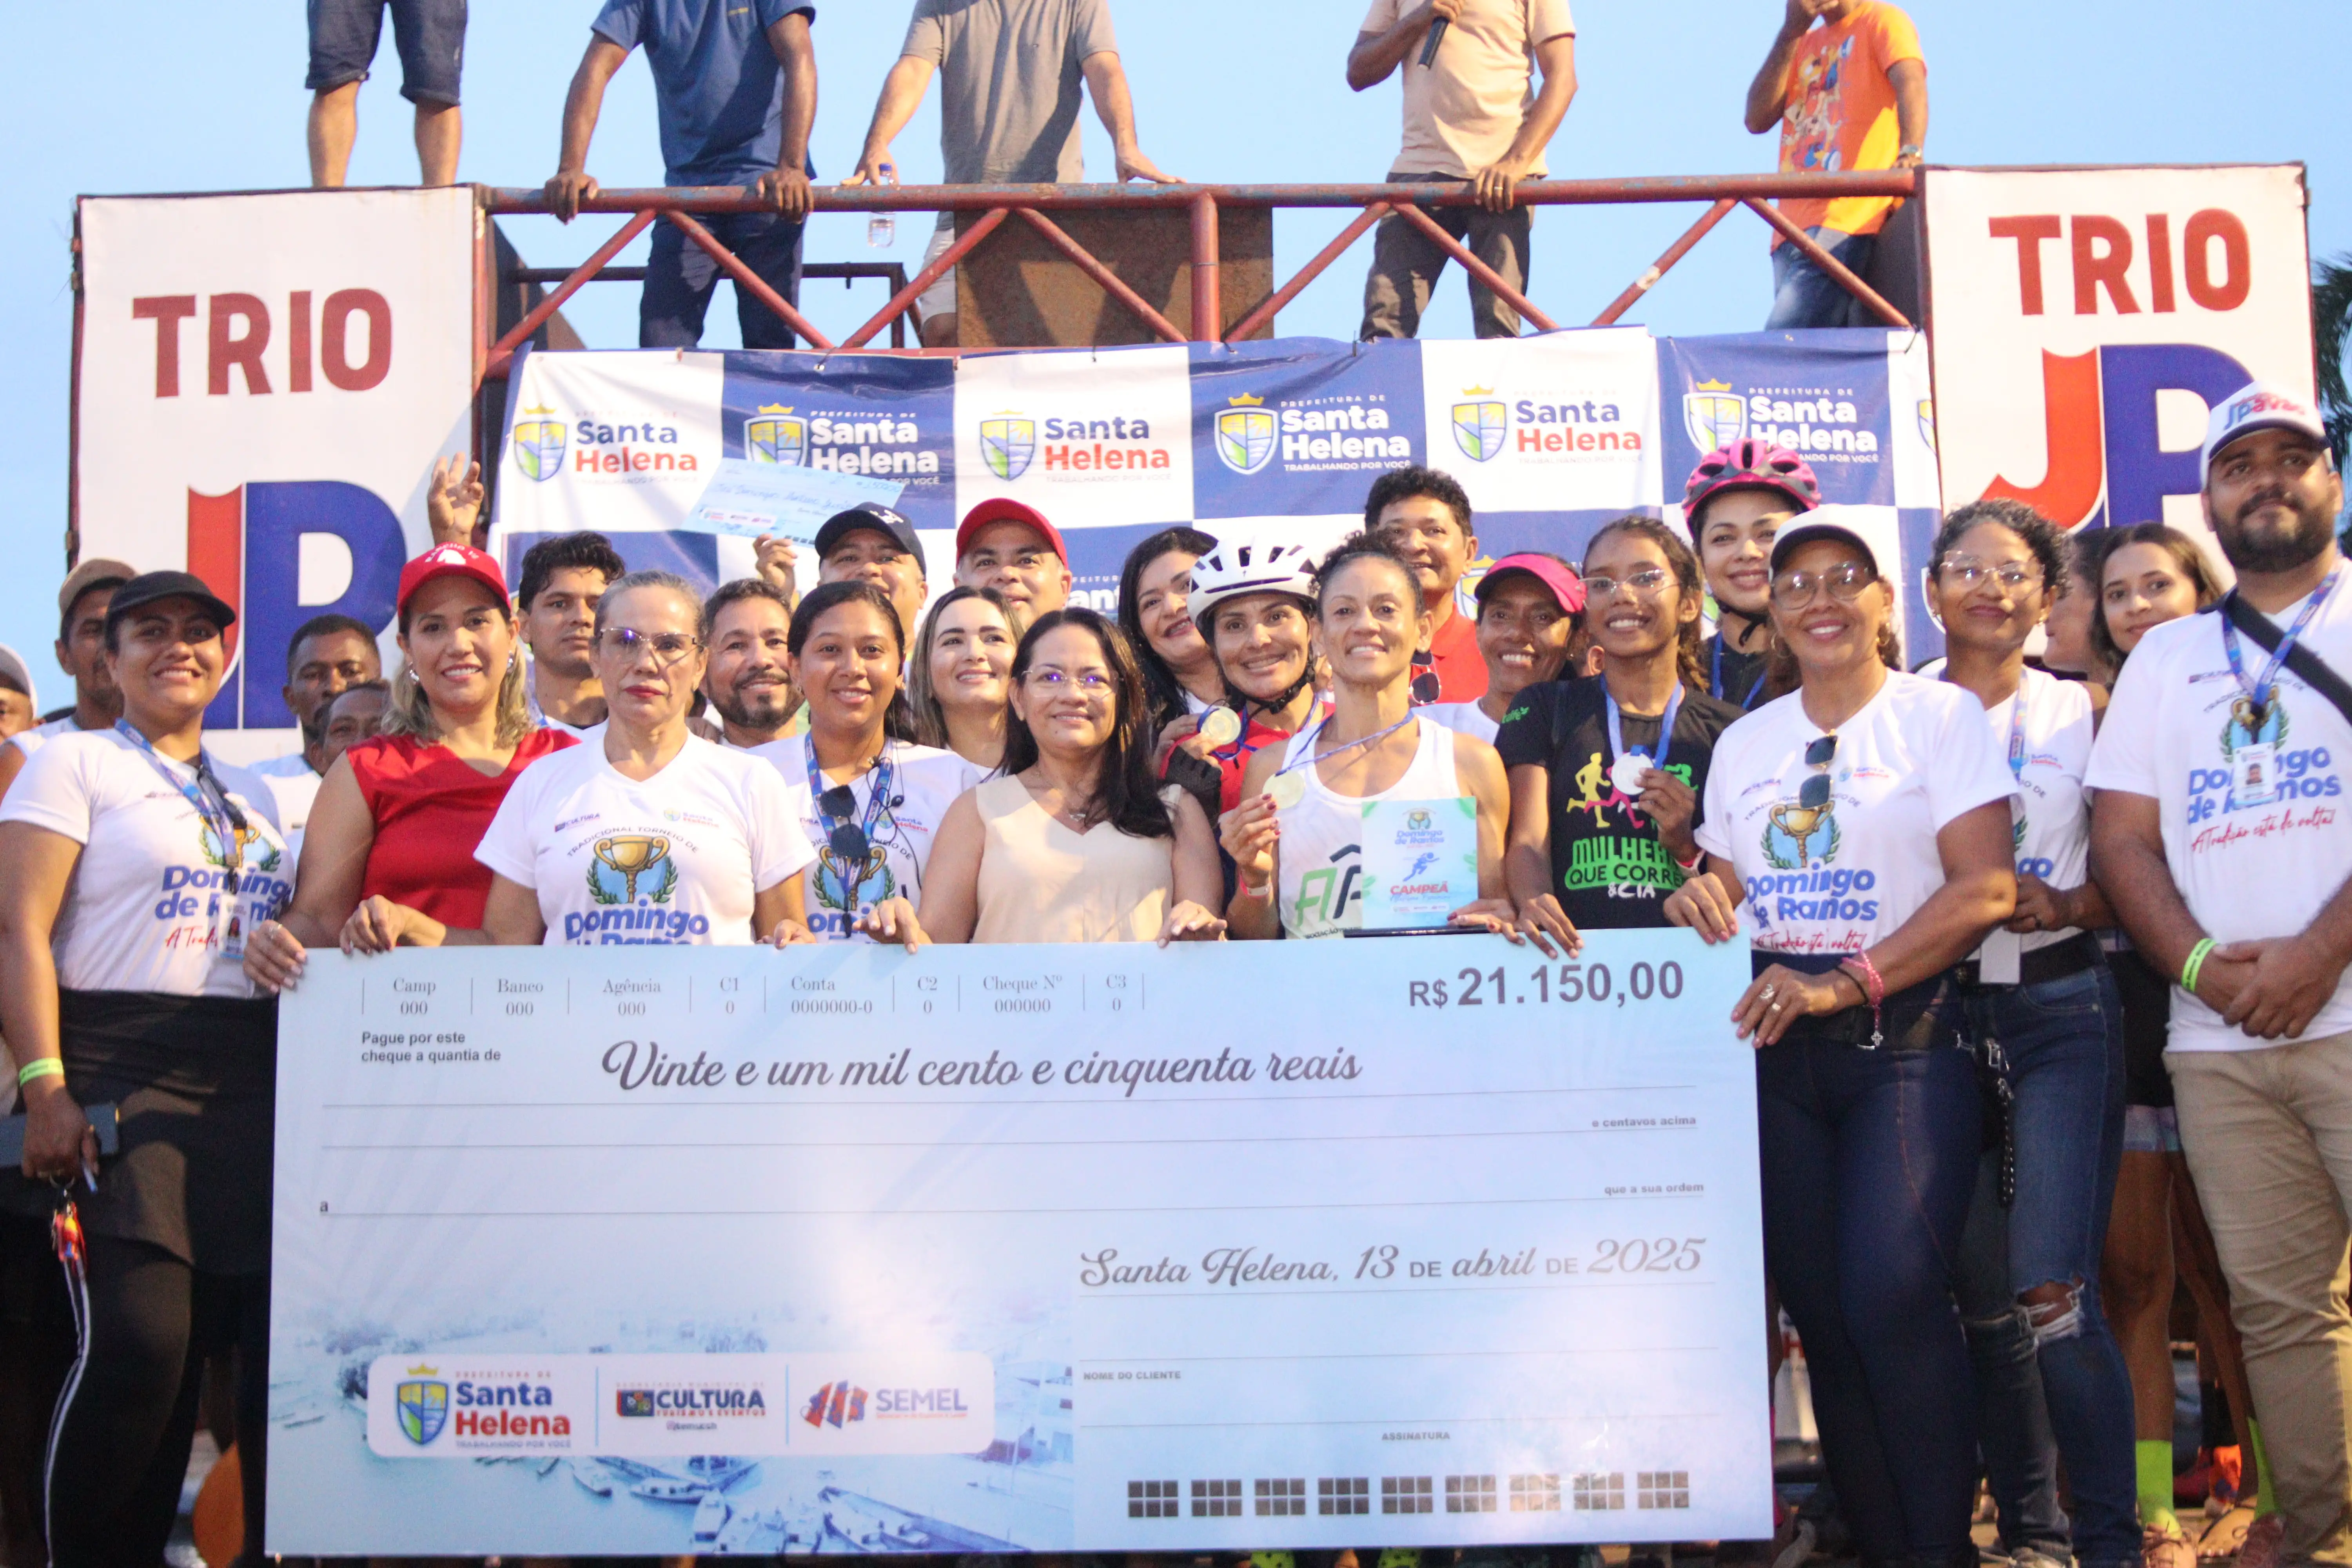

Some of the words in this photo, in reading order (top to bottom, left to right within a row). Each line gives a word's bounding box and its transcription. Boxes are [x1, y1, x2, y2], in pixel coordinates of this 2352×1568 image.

[1988, 207, 2250, 316] TRIO
[132, 288, 392, 398] TRIO
[1281, 396, 1362, 408] PREFEITURA
[1516, 400, 1619, 423] Santa
[1749, 396, 1857, 423] Santa
[1044, 417, 1149, 440] Santa
[1281, 405, 1389, 432] Santa
[577, 420, 677, 445] Santa
[810, 418, 918, 445] Santa
[1517, 427, 1641, 452] Helena
[1751, 423, 1878, 453] Helena
[1978, 343, 2255, 527] JP
[1045, 443, 1170, 471] Helena
[1282, 432, 1410, 460] Helena
[576, 446, 698, 473] Helena
[811, 446, 939, 474] Helena
[1283, 462, 1359, 471] TRABALHANDO
[1361, 461, 1382, 469] POR
[1384, 459, 1411, 468] VOCÊ
[1829, 455, 1850, 463] POR
[1851, 454, 1879, 463] VOCÊ
[912, 476, 940, 485] VOCÊ
[187, 480, 408, 730] JP
[1847, 797, 1861, 808] DE
[2188, 796, 2216, 825] de
[564, 813, 601, 826] CULTURA
[567, 826, 634, 857] TRADICIONAL
[638, 826, 684, 843] TORNEIO
[685, 840, 699, 854] DE
[899, 848, 913, 860] DE
[1570, 865, 1608, 885] QUE
[1390, 880, 1448, 895] CAMPEÃ
[1608, 880, 1656, 899] &CIA
[152, 891, 198, 920] de
[564, 898, 710, 940] Domingo
[393, 977, 436, 995] Camp
[497, 978, 544, 994] Banco
[602, 978, 661, 995] Agência
[720, 977, 739, 992] C1
[791, 976, 836, 991] Conta
[917, 976, 938, 991] C2
[983, 975, 1038, 994] Cheque
[1105, 974, 1127, 989] C3
[1408, 979, 1448, 1010] R$
[1457, 960, 1684, 1008] 21.150,00
[400, 1000, 428, 1016] 000
[505, 1001, 534, 1016] 000
[617, 1001, 646, 1017] 000
[725, 1000, 735, 1014] 0
[791, 999, 873, 1014] 0000000-0
[923, 999, 933, 1014] 0
[994, 998, 1051, 1013] 000000
[1112, 997, 1122, 1012] 0
[361, 1031, 405, 1045] Pague
[409, 1033, 433, 1046] por
[436, 1031, 466, 1044] este
[361, 1049, 412, 1063] cheque
[416, 1051, 424, 1062] a
[428, 1048, 480, 1063] quantia
[484, 1048, 501, 1061] de
[601, 1040, 727, 1091] Vinte
[735, 1061, 760, 1086] e
[767, 1058, 833, 1086] um
[839, 1048, 911, 1086] mil
[918, 1049, 1024, 1086] cento
[1031, 1060, 1056, 1085] e
[1064, 1047, 1256, 1098] cinquenta
[1265, 1046, 1363, 1082] reais
[1602, 1117, 1656, 1127] centavos
[1660, 1115, 1697, 1125] acima
[1604, 1186, 1627, 1196] que
[1641, 1184, 1662, 1193] sua
[1665, 1182, 1704, 1193] ordem
[319, 1201, 328, 1212] a
[1080, 1248, 1191, 1287] Santa
[1201, 1246, 1340, 1288] Helena,
[1354, 1245, 1399, 1281] 13
[1409, 1262, 1442, 1278] DE
[1452, 1247, 1536, 1277] abril
[1546, 1258, 1578, 1275] DE
[1587, 1237, 1707, 1273] 2025
[1083, 1372, 1114, 1381] NOME
[1117, 1371, 1133, 1380] DO
[1135, 1370, 1181, 1380] CLIENTE
[456, 1381, 552, 1406] Santa
[656, 1389, 765, 1409] CULTURA
[876, 1388, 968, 1412] SEMEL
[455, 1410, 570, 1436] Helena
[526, 1439, 545, 1448] POR
[1381, 1431, 1451, 1442] ASSINATURA
